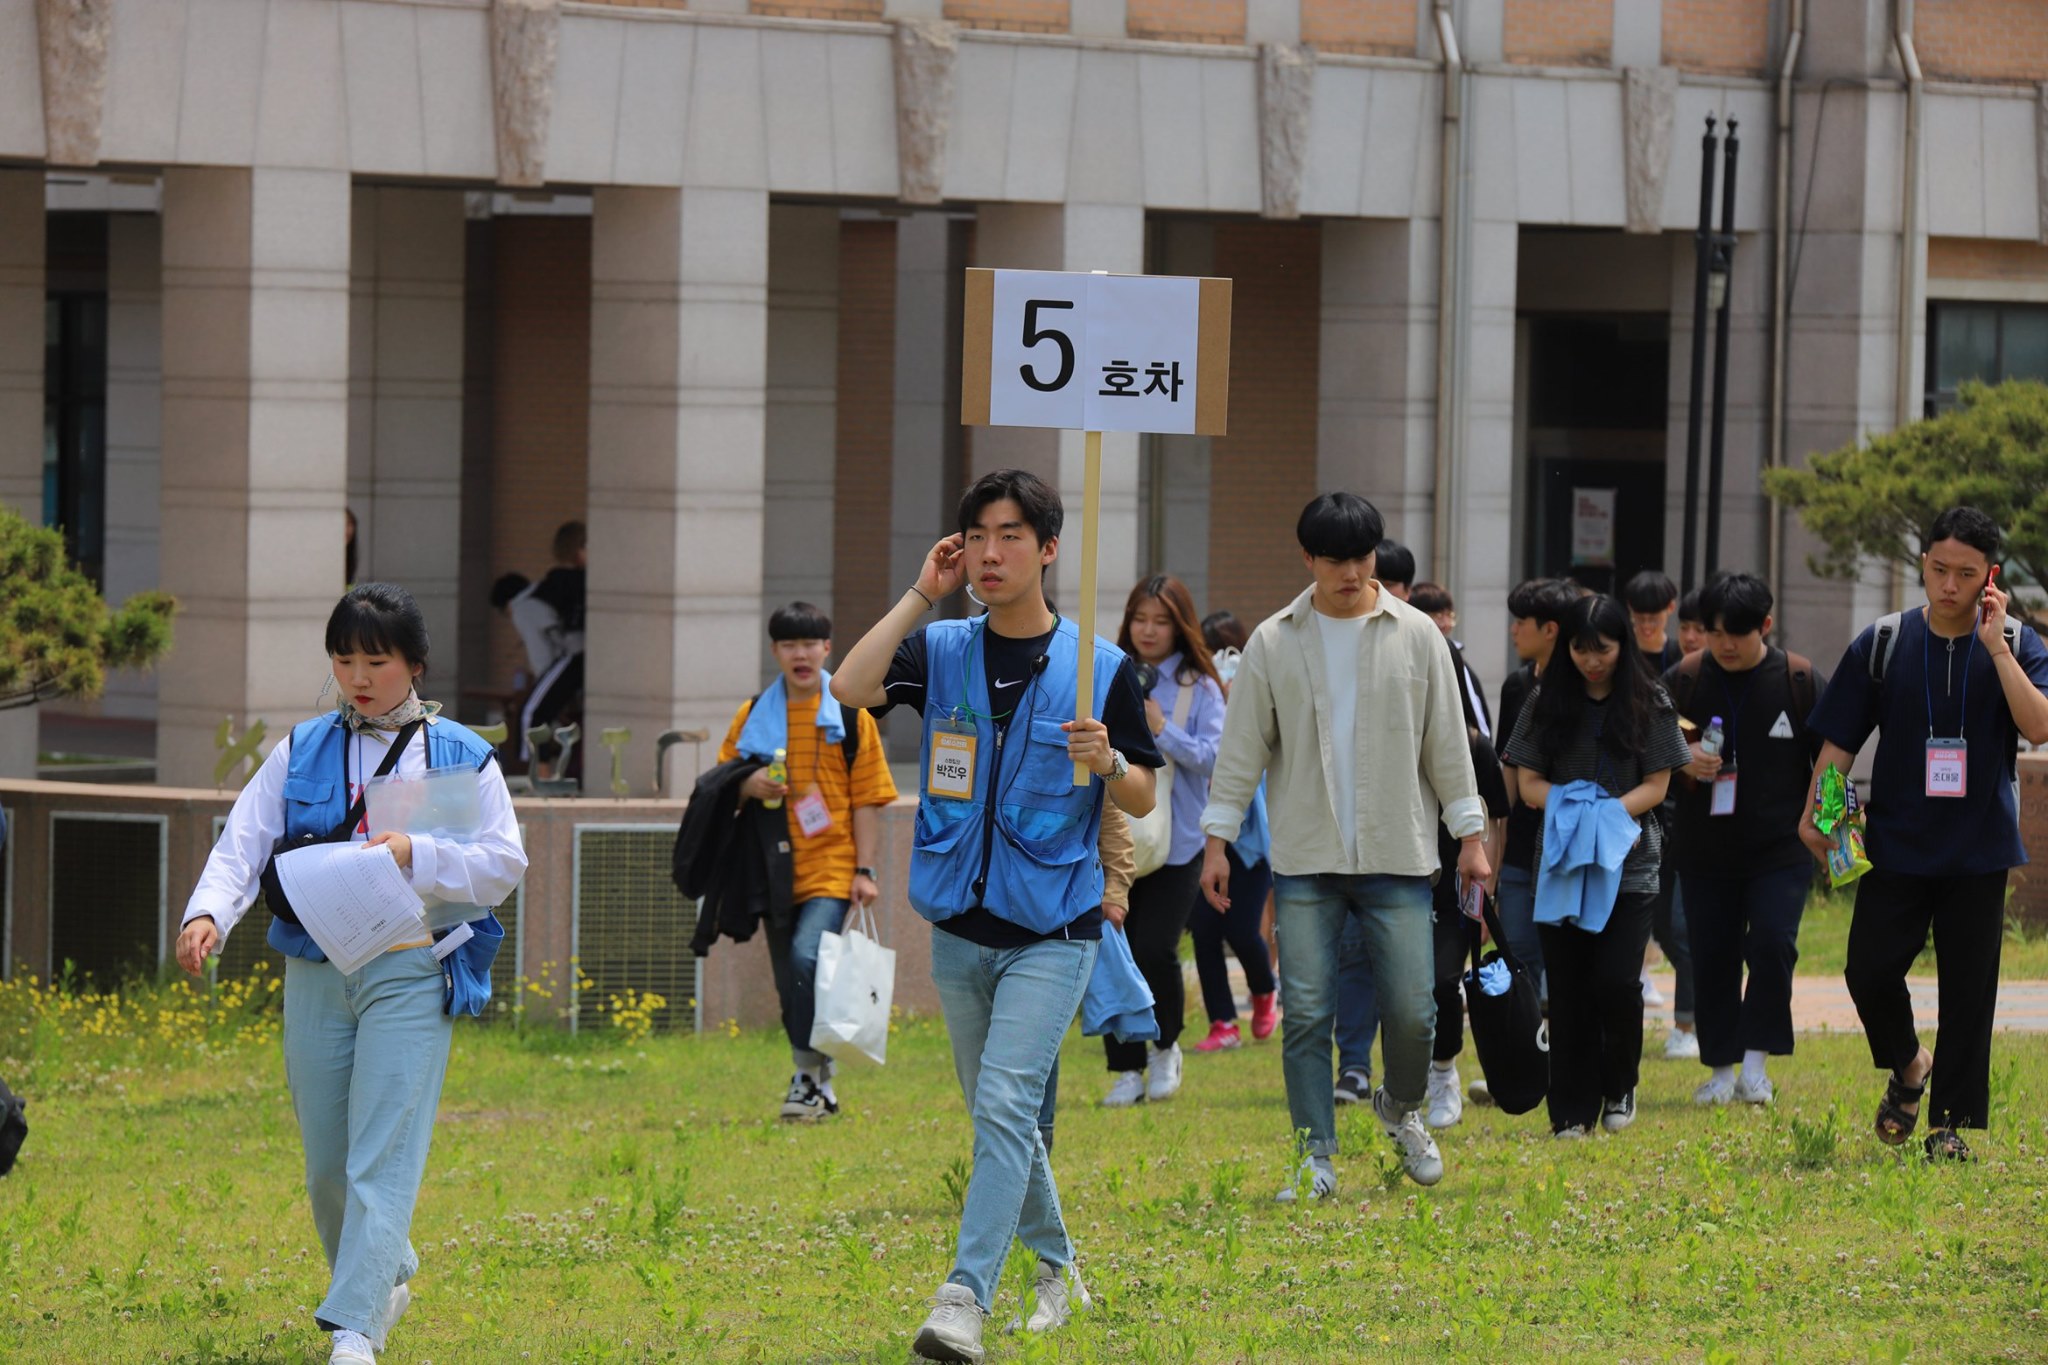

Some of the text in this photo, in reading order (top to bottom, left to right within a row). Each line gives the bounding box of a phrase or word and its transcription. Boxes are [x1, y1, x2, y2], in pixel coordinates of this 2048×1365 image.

[1019, 299, 1184, 402] 5 호차
[936, 764, 967, 780] 박진우
